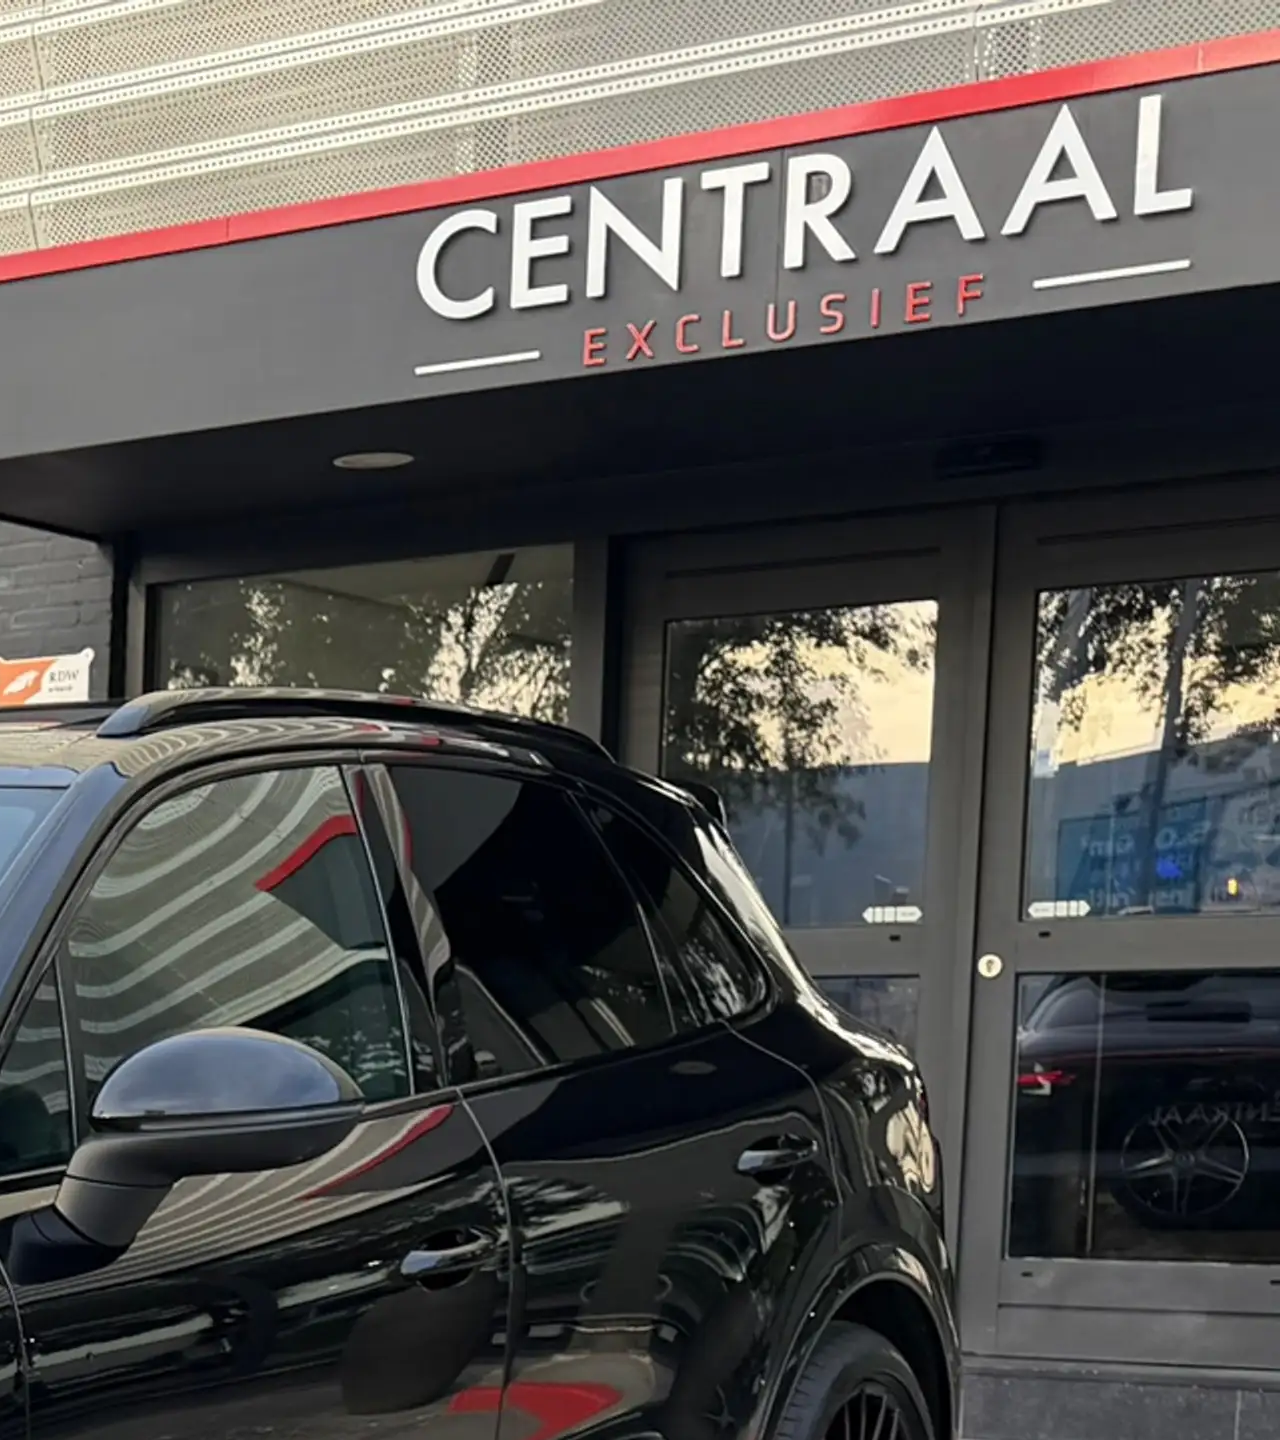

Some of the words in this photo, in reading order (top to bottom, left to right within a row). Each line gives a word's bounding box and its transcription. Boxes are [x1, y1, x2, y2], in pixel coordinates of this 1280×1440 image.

[415, 93, 1194, 322] CENTRAAL
[581, 272, 986, 368] EXCLUSIEF
[49, 669, 80, 684] RDW
